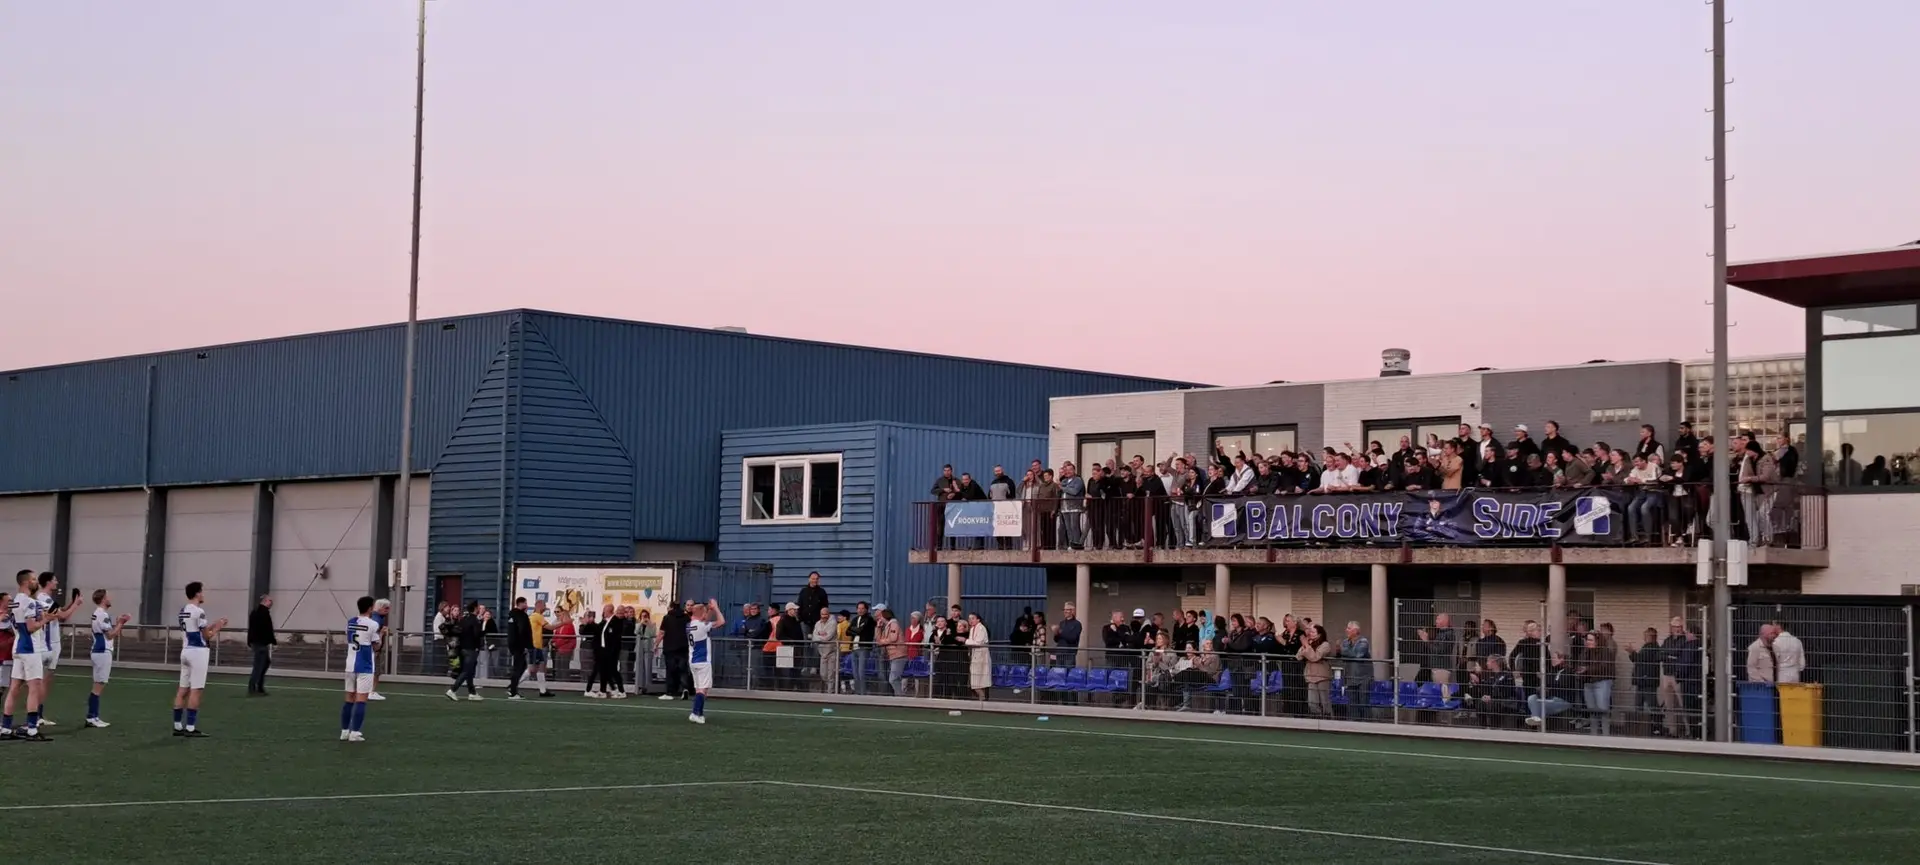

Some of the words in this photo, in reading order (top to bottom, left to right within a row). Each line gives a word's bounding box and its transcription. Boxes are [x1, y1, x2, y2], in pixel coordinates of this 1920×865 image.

[958, 517, 989, 525] ROOKVRIJ
[1246, 501, 1403, 539] BALCONY
[1473, 497, 1561, 538] SIDE
[352, 633, 360, 651] 5
[688, 633, 695, 647] 8
